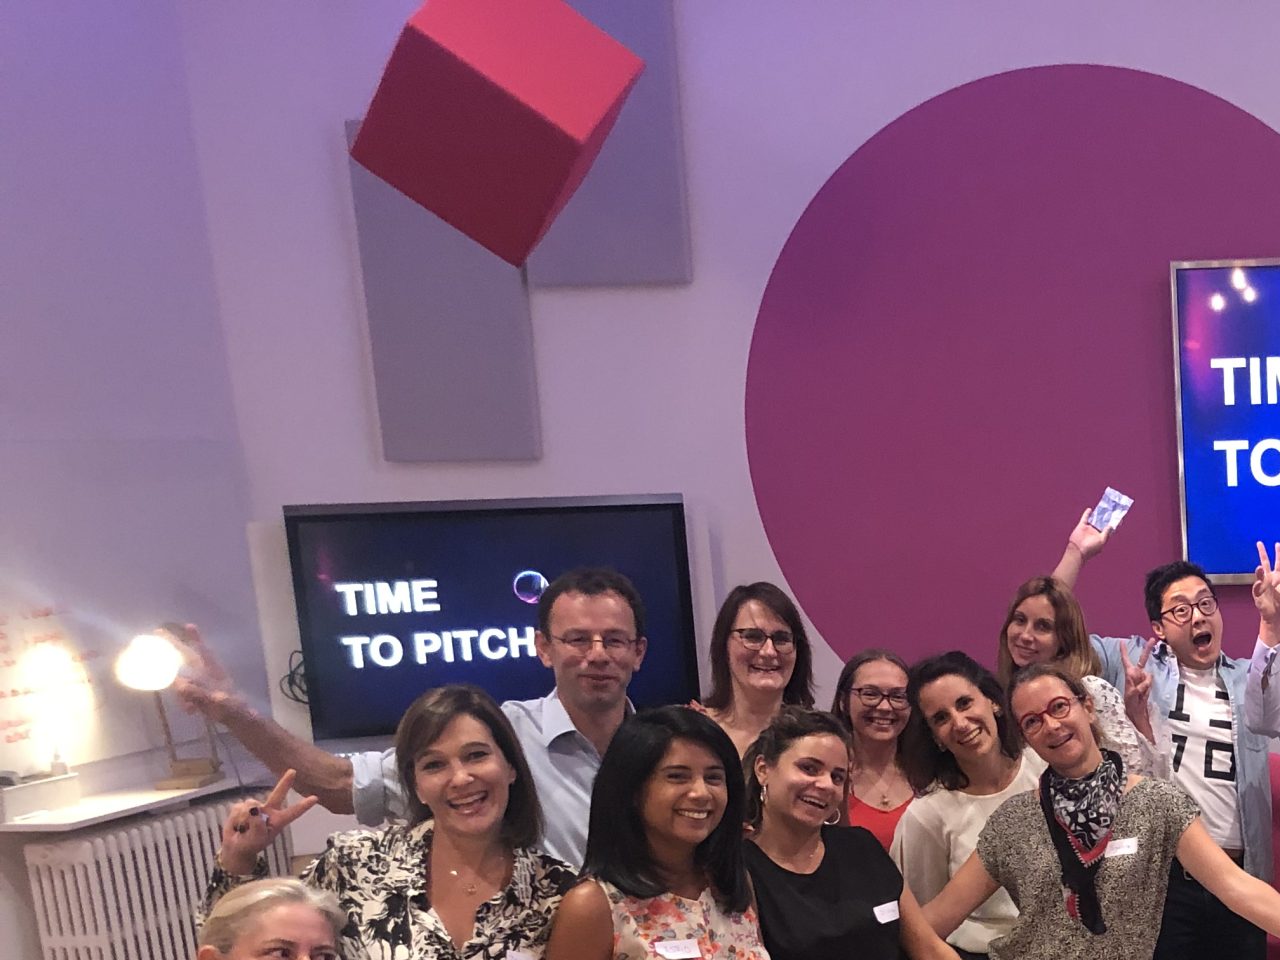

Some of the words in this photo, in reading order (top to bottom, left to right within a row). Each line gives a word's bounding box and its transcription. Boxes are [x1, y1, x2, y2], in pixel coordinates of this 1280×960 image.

[333, 579, 441, 616] TIME
[340, 633, 404, 669] TO
[413, 626, 538, 665] PITCH
